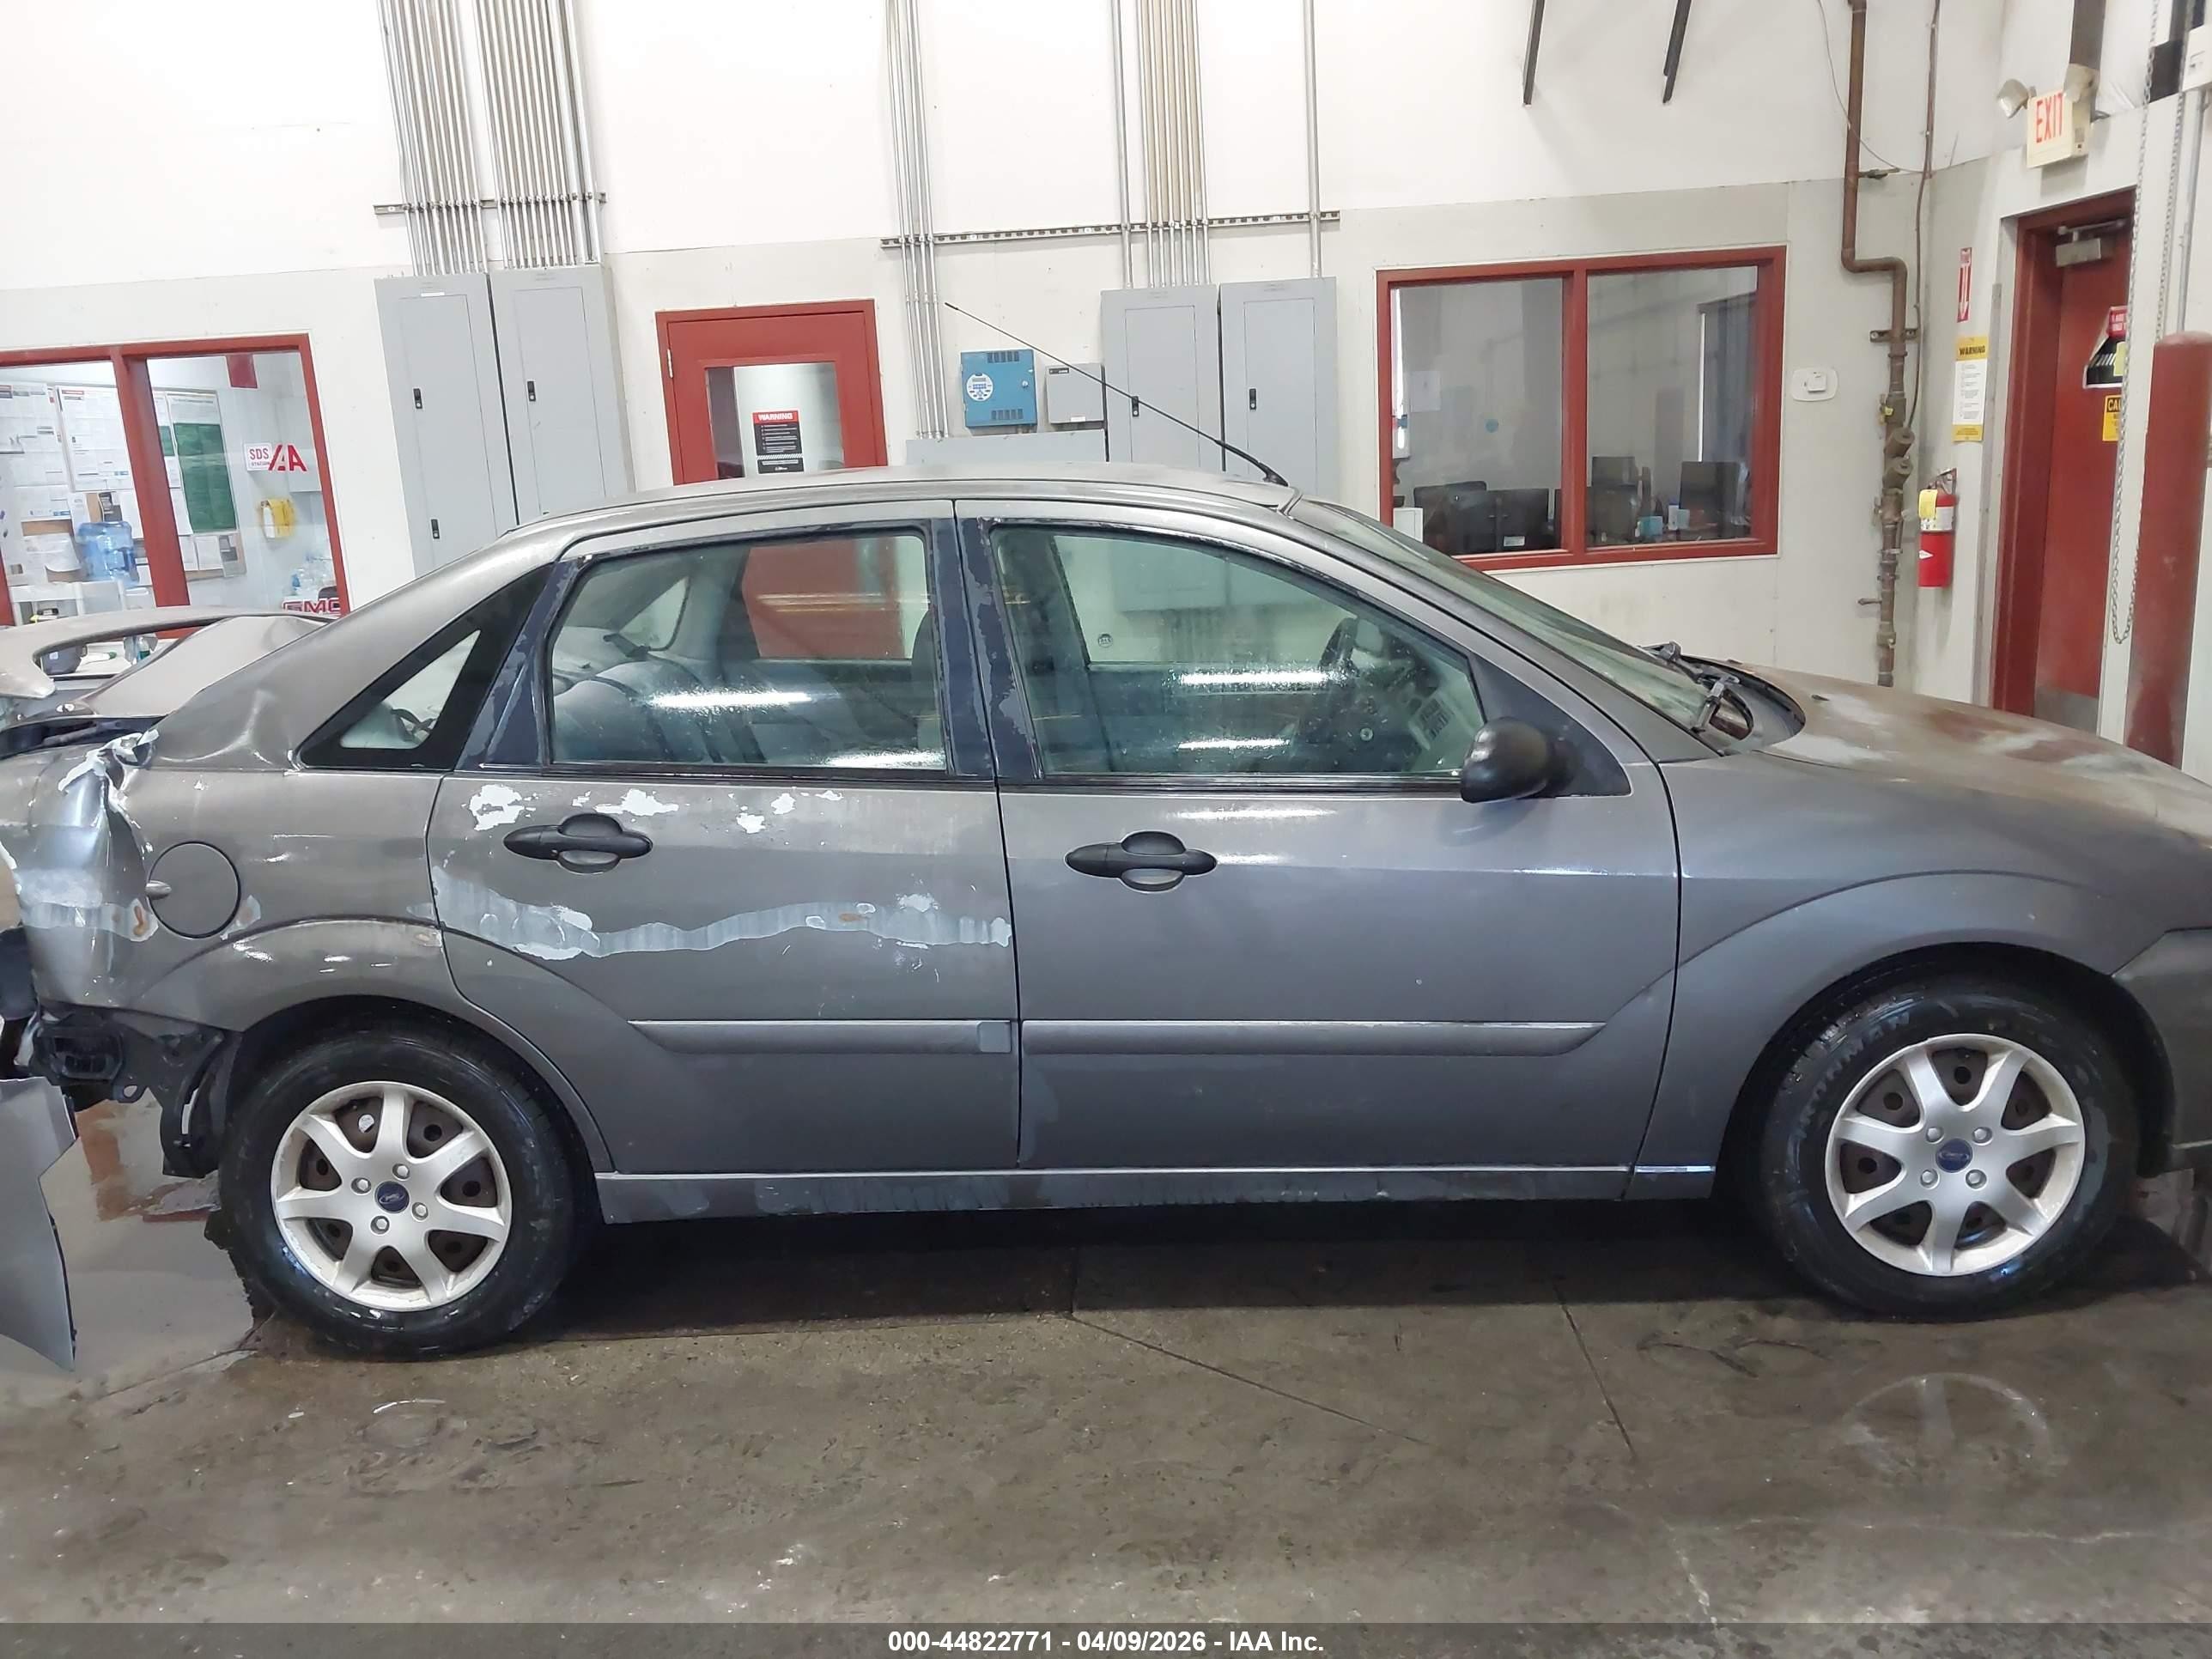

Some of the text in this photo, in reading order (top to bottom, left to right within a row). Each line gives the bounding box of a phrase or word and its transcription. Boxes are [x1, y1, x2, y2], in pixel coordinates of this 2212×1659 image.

[2036, 91, 2063, 143] EXIT
[1959, 345, 1986, 356] WARNING
[757, 412, 793, 421] WARNING
[249, 447, 270, 460] SDS
